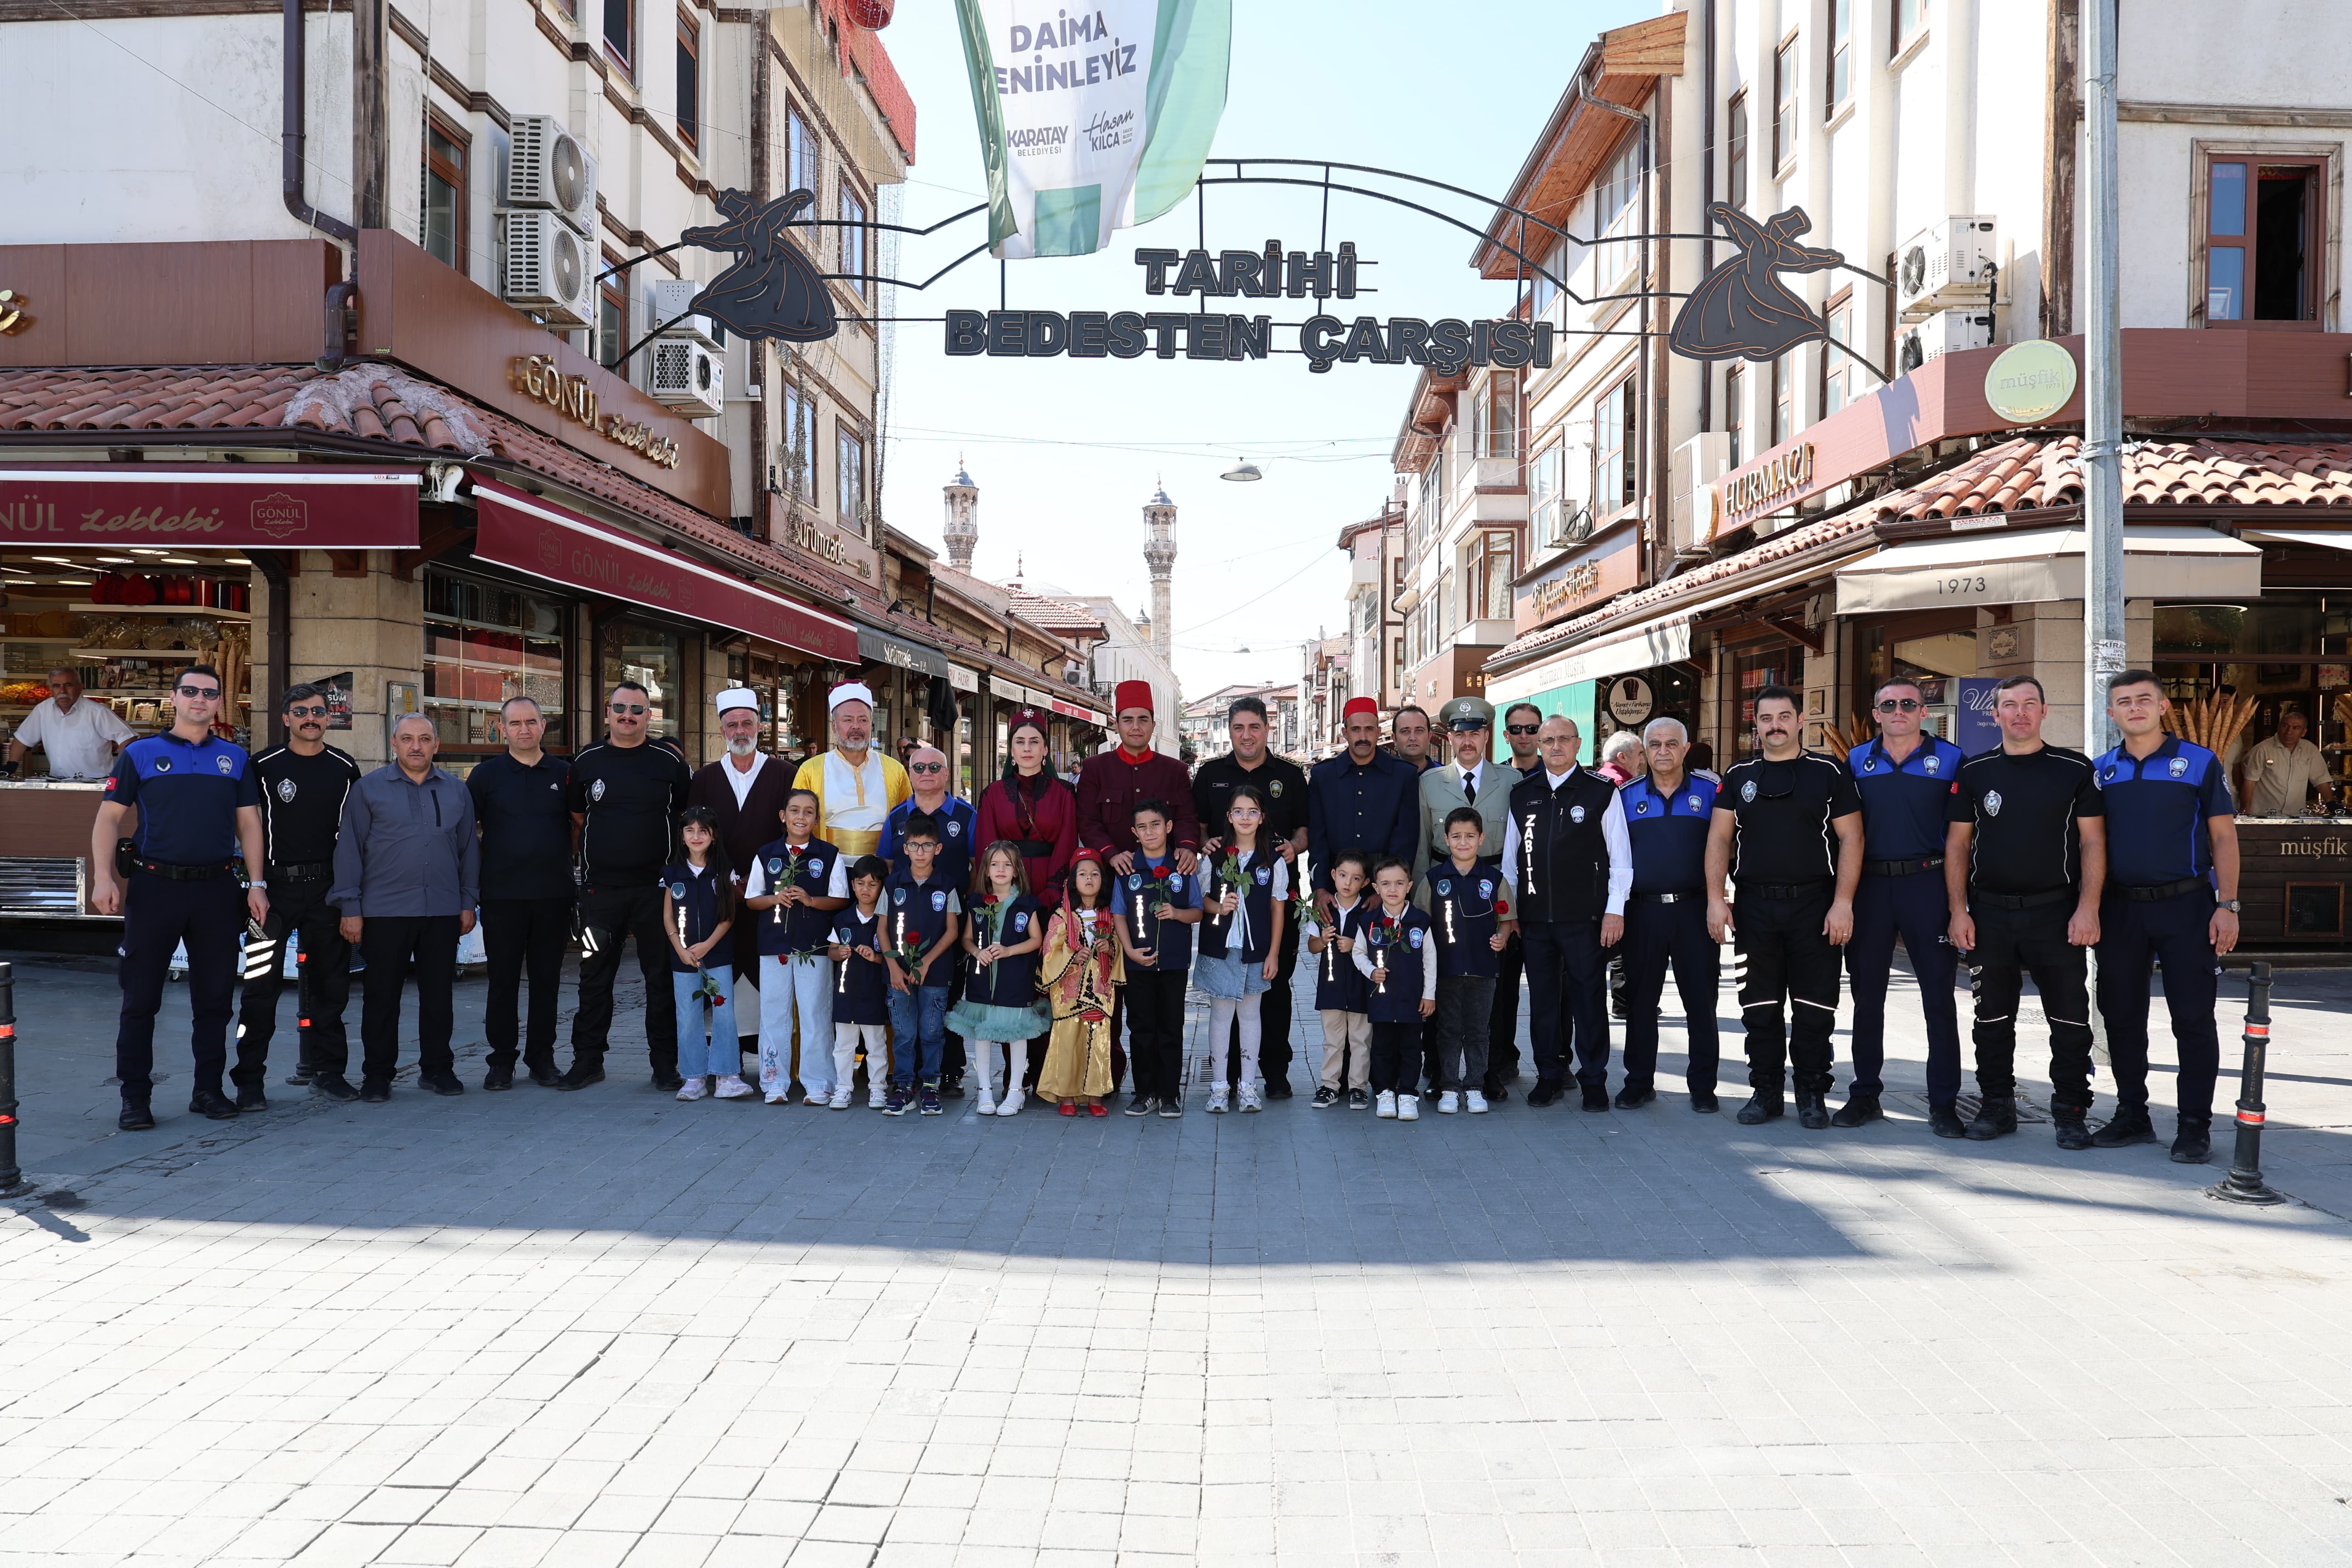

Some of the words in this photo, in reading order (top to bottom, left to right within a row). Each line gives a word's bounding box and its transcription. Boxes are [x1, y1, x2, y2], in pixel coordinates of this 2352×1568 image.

[1011, 9, 1108, 53] DAİMA
[1007, 125, 1069, 147] KARATAY
[1083, 110, 1134, 141] Hasan
[1018, 146, 1061, 157] BELEDİYESİ
[1135, 239, 1357, 299] TARİHİ
[944, 309, 1272, 361] BEDESTEN
[1301, 314, 1554, 377] ÇARŞISI
[523, 354, 605, 433] GÖNÜL
[2000, 368, 2060, 389] müşfik
[1724, 442, 1811, 517] HURMACI
[80, 506, 224, 532] Leblebi
[257, 506, 301, 519] GÖNÜL
[571, 546, 623, 587] GÖNÜL
[626, 572, 672, 600] Leblebi
[1937, 577, 1985, 594] 1973
[773, 615, 798, 640] GÖNÜL
[1539, 667, 1562, 686] Hurmacı
[1564, 655, 1586, 679] Müşfik
[1524, 814, 1536, 895] ZABITA
[2281, 837, 2348, 859] müşfik
[1136, 895, 1146, 939] ZABITA
[1445, 900, 1456, 944] ZABITA
